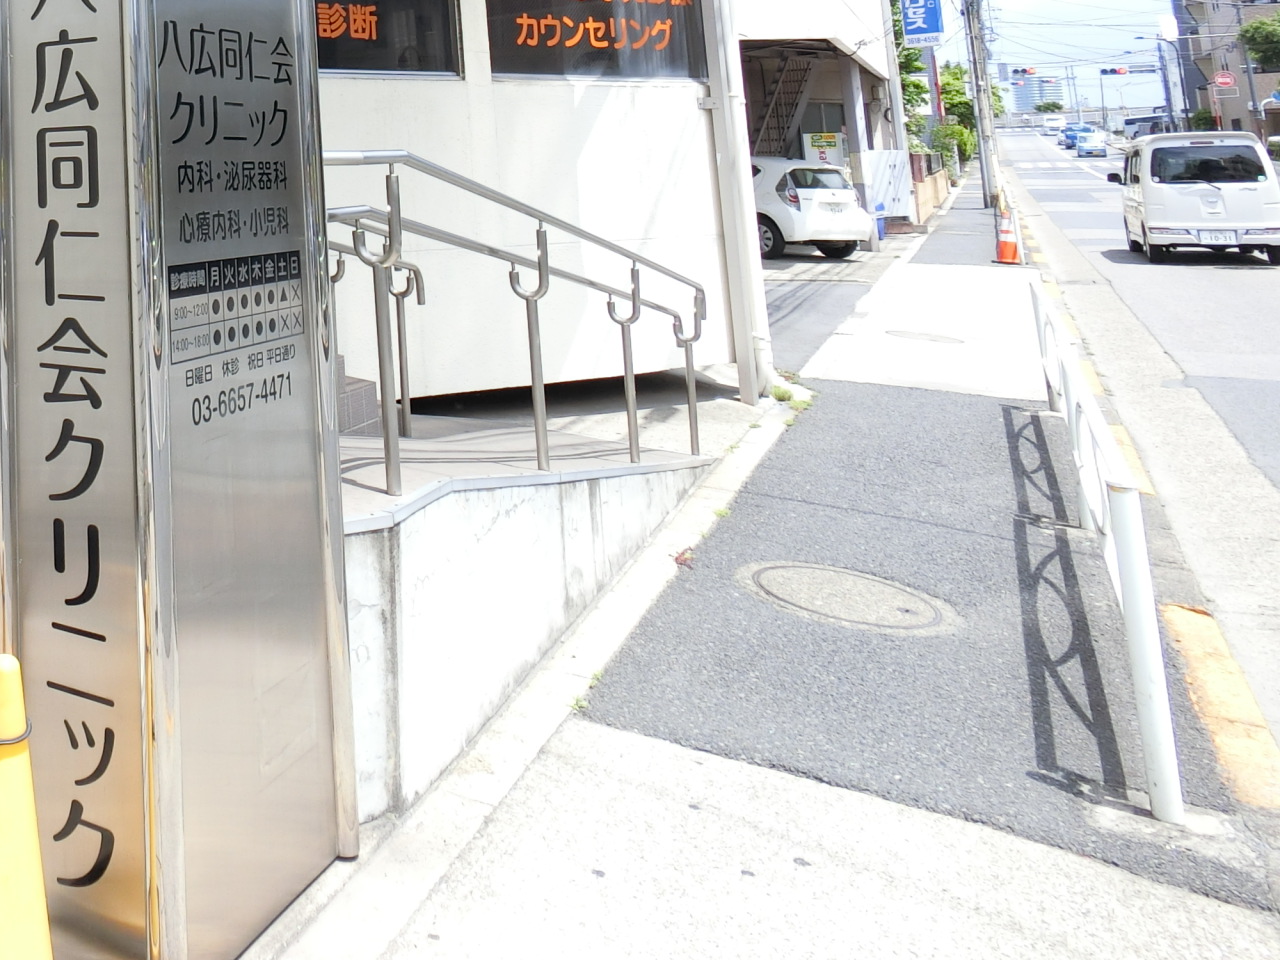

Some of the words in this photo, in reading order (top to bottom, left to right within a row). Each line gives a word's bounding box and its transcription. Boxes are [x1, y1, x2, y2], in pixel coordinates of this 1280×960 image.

[158, 19, 293, 86] 八広同仁会
[516, 13, 672, 51] カウンセリング
[170, 91, 288, 147] クリニック
[178, 160, 287, 193] 内科・泌尿器科
[179, 207, 289, 244] 心療内科・小児科
[170, 269, 206, 291] 診療時間
[210, 267, 220, 287] 月
[224, 264, 235, 285] 火
[238, 263, 249, 282] 水
[252, 261, 262, 280] 木
[265, 259, 275, 277] 金
[279, 258, 287, 276] 土
[291, 256, 299, 274] 日
[185, 364, 213, 388] 日曜日
[222, 358, 240, 378] 休診
[247, 351, 264, 371] 祝日
[267, 344, 296, 366] 平日通り
[191, 371, 292, 426] 03-6657-4471
